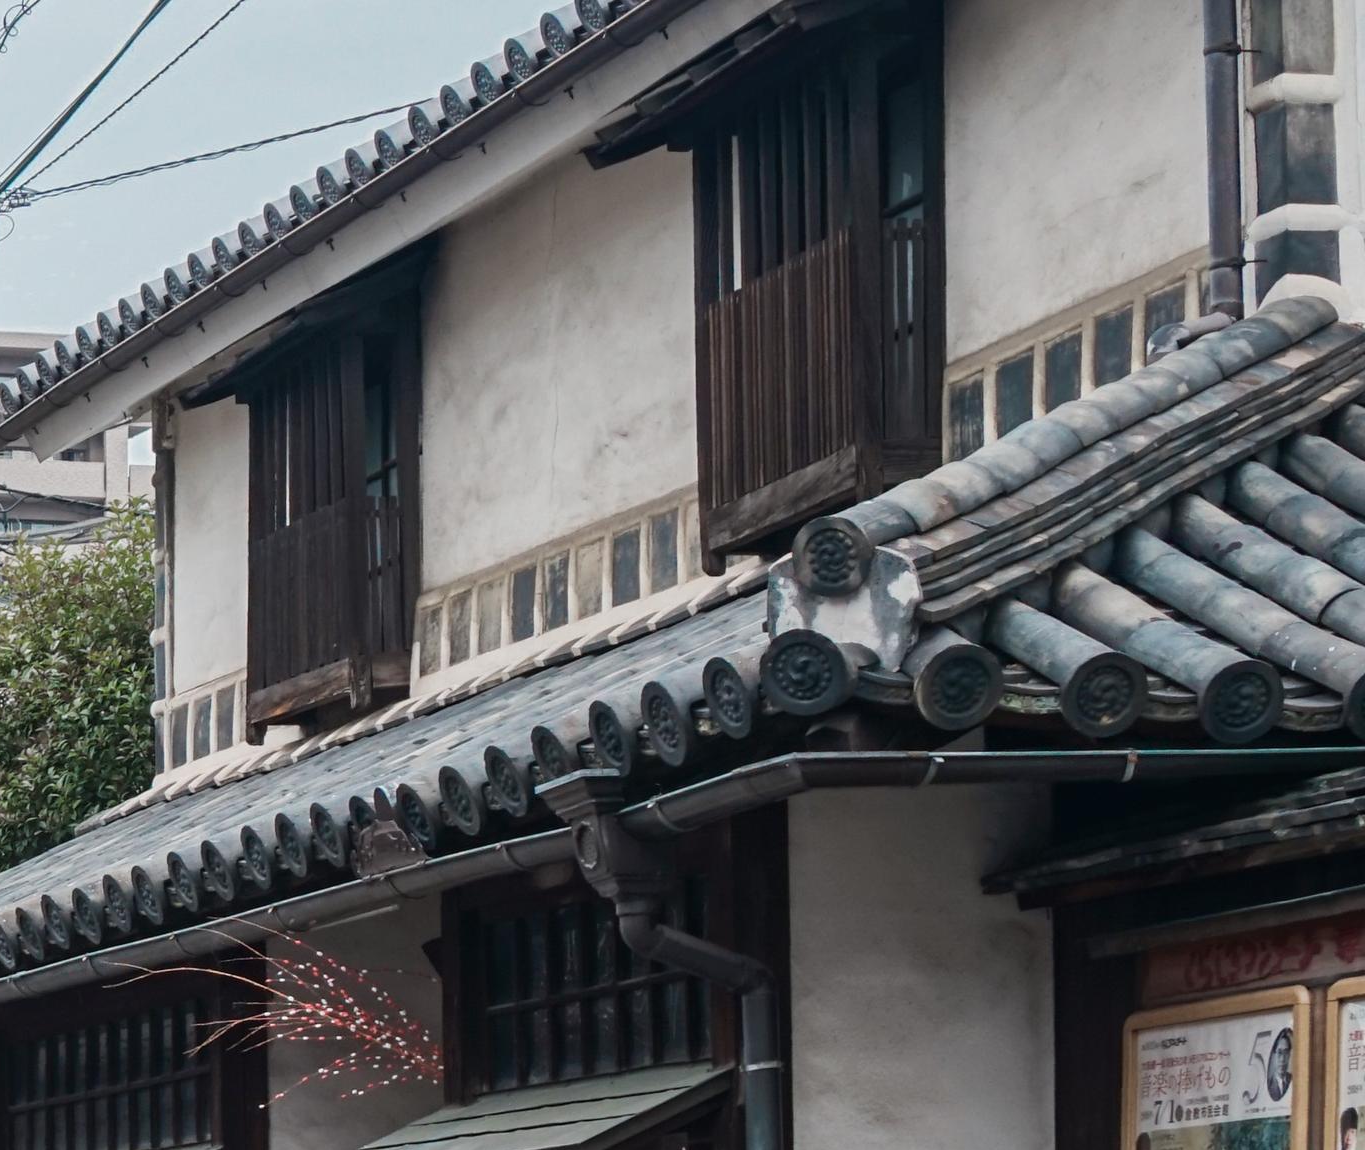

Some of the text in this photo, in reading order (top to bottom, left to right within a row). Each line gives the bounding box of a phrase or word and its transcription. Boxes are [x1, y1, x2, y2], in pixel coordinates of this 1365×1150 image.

[1185, 1104, 1229, 1120] 倉敷市民会館
